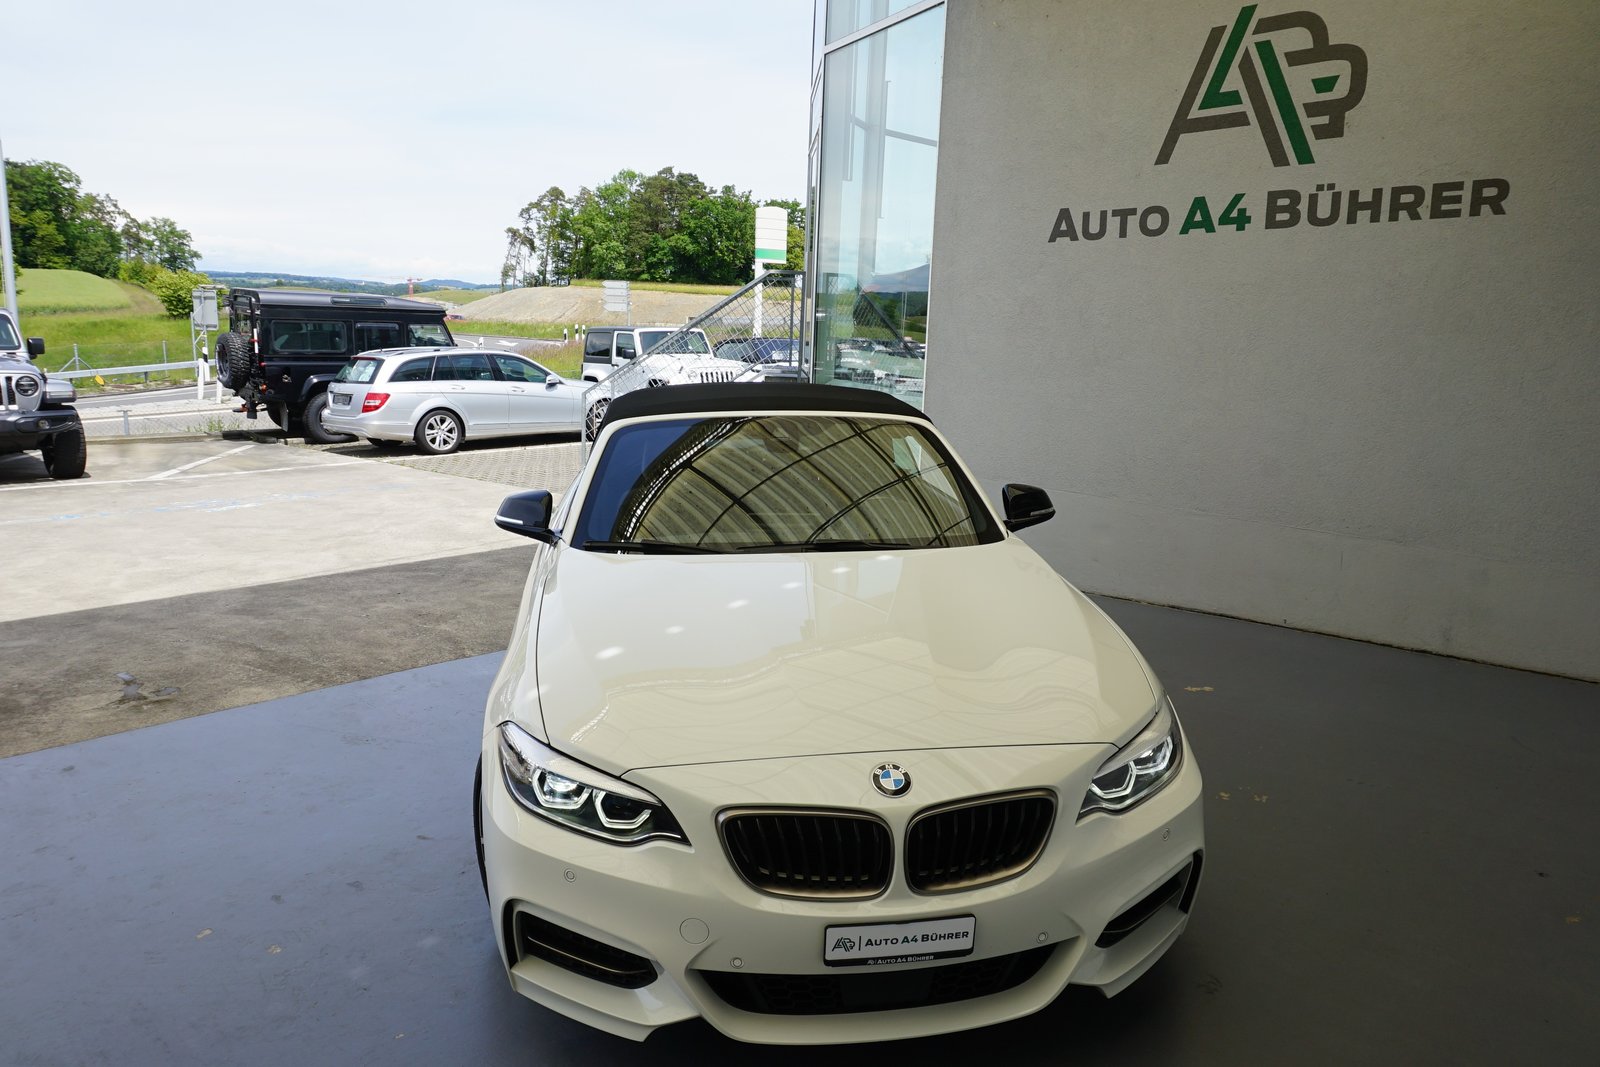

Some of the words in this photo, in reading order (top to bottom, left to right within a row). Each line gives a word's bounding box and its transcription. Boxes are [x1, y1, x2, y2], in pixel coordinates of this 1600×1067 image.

[1048, 206, 1170, 243] AUTO
[1179, 193, 1252, 235] A4
[1264, 178, 1511, 231] BÜHRER
[865, 937, 899, 947] AUTO
[901, 935, 919, 945] A4
[921, 931, 969, 942] BÜHRER
